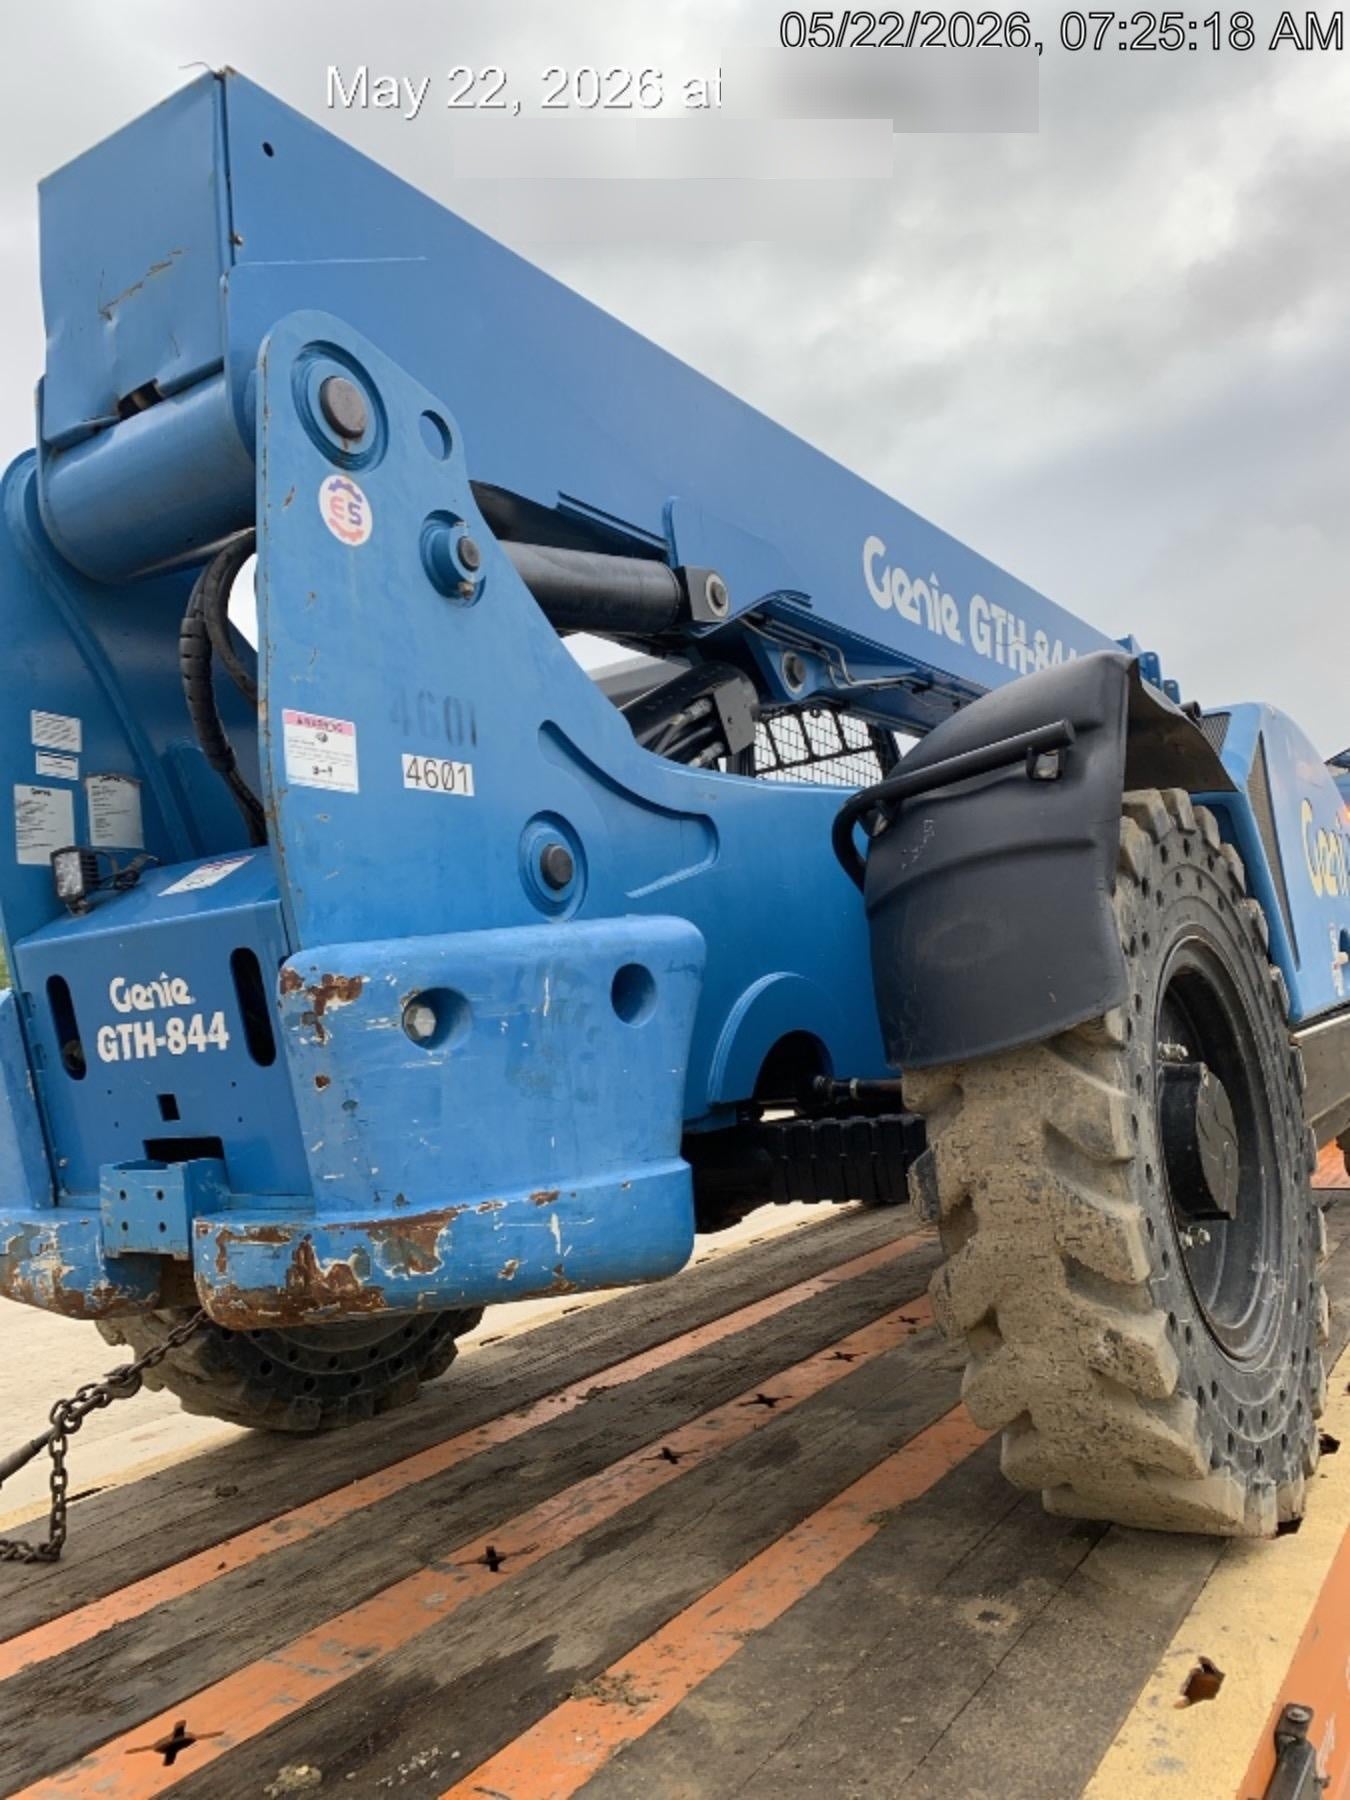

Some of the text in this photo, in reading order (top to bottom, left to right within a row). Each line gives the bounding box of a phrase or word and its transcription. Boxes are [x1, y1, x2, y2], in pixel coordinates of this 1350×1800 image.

[863, 535, 965, 647] Genie
[405, 756, 469, 793] 4601
[109, 971, 196, 1013] Genie
[97, 1012, 230, 1063] GTH-844
